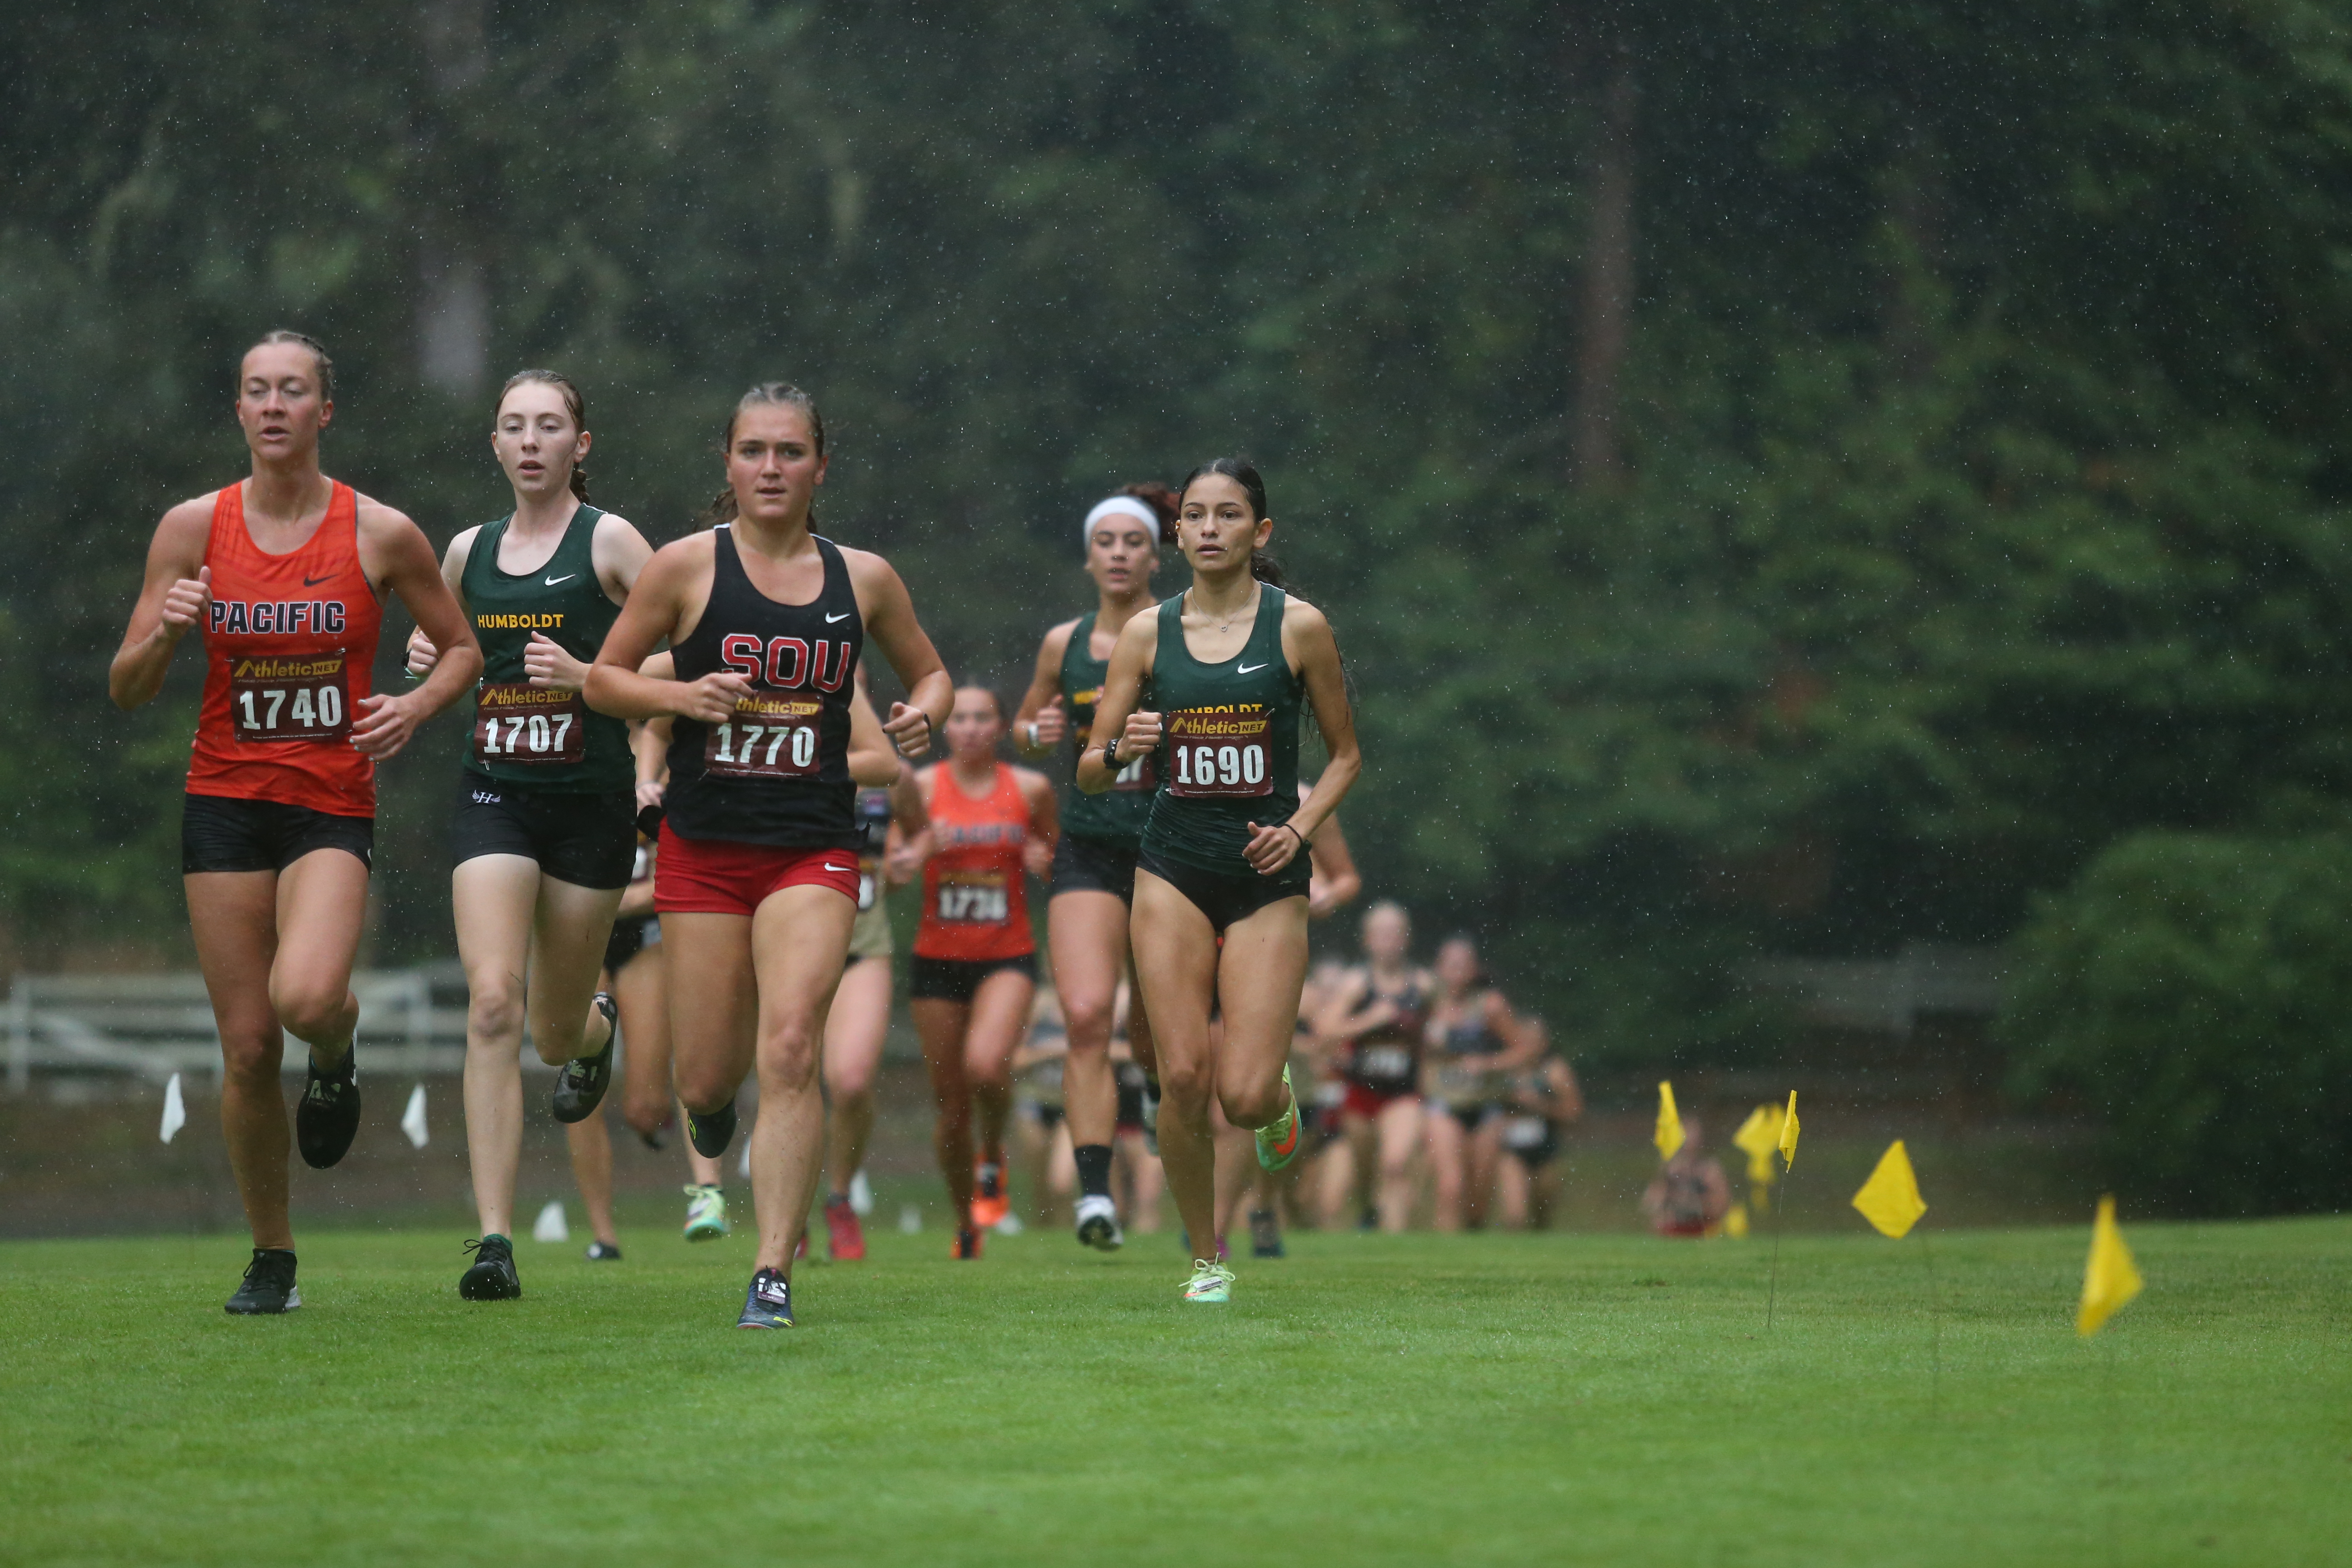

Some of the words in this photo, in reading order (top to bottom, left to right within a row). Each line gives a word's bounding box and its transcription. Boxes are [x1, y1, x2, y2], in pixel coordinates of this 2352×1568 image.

[210, 601, 345, 634] PACIFIC
[478, 614, 564, 628] HUMBOLDT
[722, 633, 851, 693] SOU
[240, 686, 342, 730] 1740
[735, 696, 790, 714] thletic
[1173, 704, 1263, 714] BOLDT
[484, 713, 573, 753] 1707
[715, 723, 815, 767] 1770
[1177, 745, 1264, 785] 1690
[476, 792, 494, 804] H
